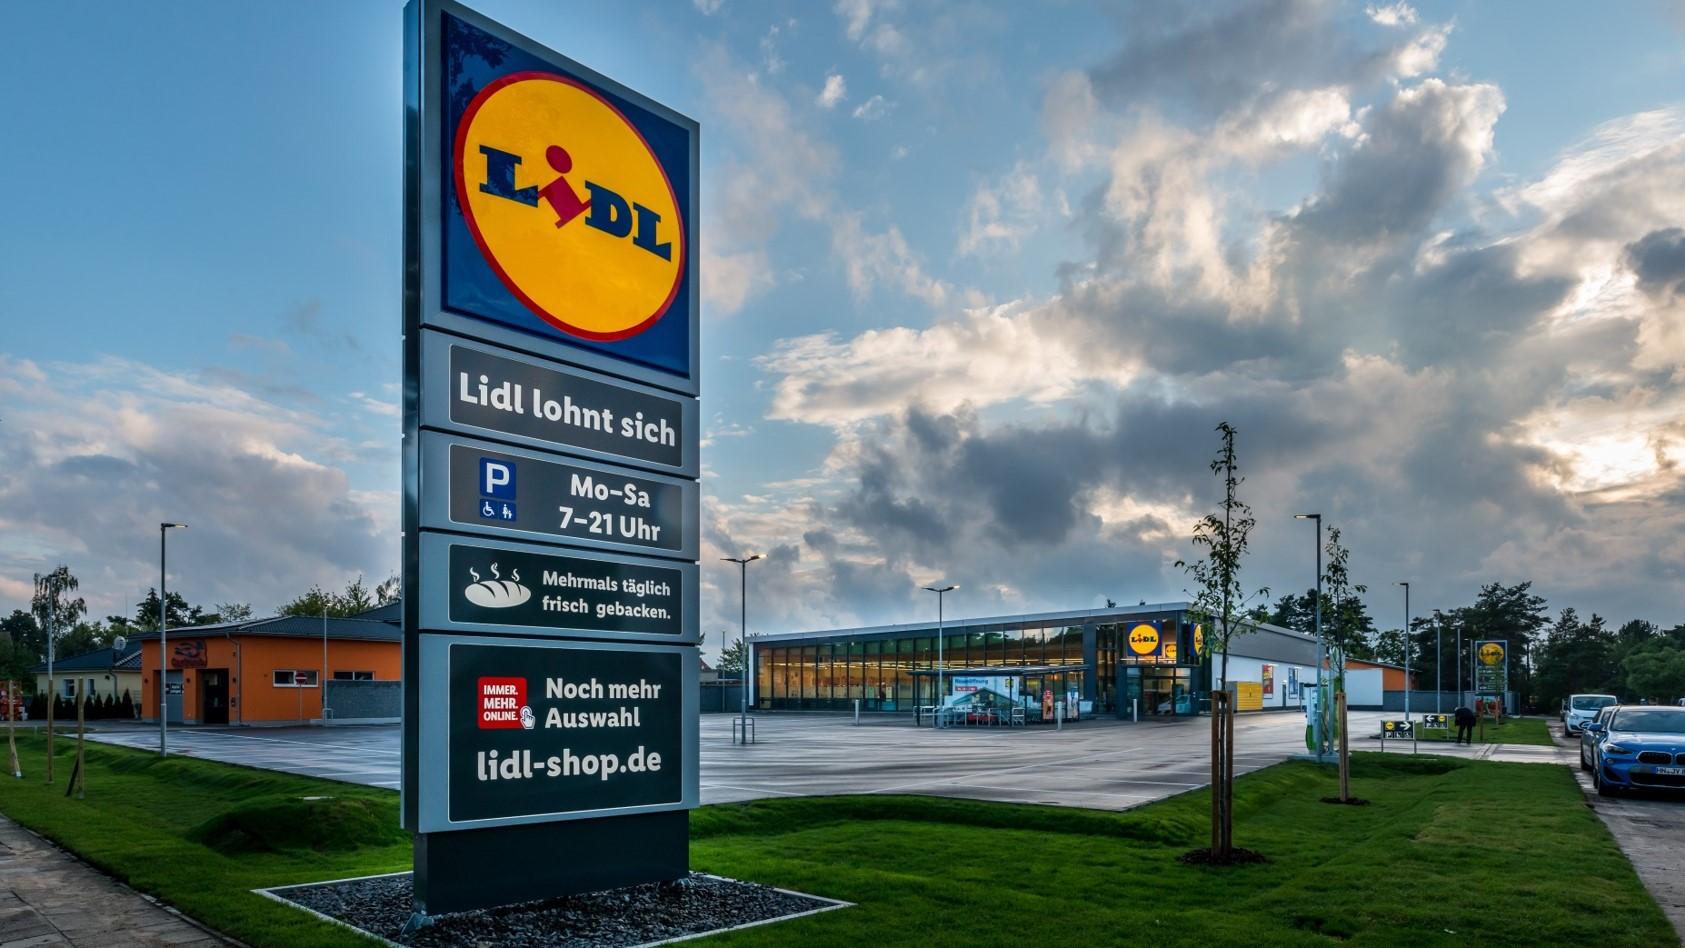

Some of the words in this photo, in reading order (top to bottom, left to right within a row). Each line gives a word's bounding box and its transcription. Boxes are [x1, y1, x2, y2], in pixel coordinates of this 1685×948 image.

[460, 371, 524, 414] Lidl
[533, 388, 614, 434] lohnt
[621, 411, 676, 447] sich
[486, 462, 510, 493] P
[619, 514, 661, 541] Uhr
[542, 570, 618, 592] Mehrmals
[622, 579, 671, 598] täglich
[542, 595, 589, 614] frisch
[596, 602, 671, 620] gebacken.
[483, 684, 519, 696] IMMER.
[546, 677, 604, 700] Noch
[608, 679, 662, 700] mehr
[483, 697, 519, 710] MEHR.
[483, 711, 519, 722] ONLINE.
[545, 706, 641, 729] Auswahl
[477, 745, 662, 781] lidl-shop.de
